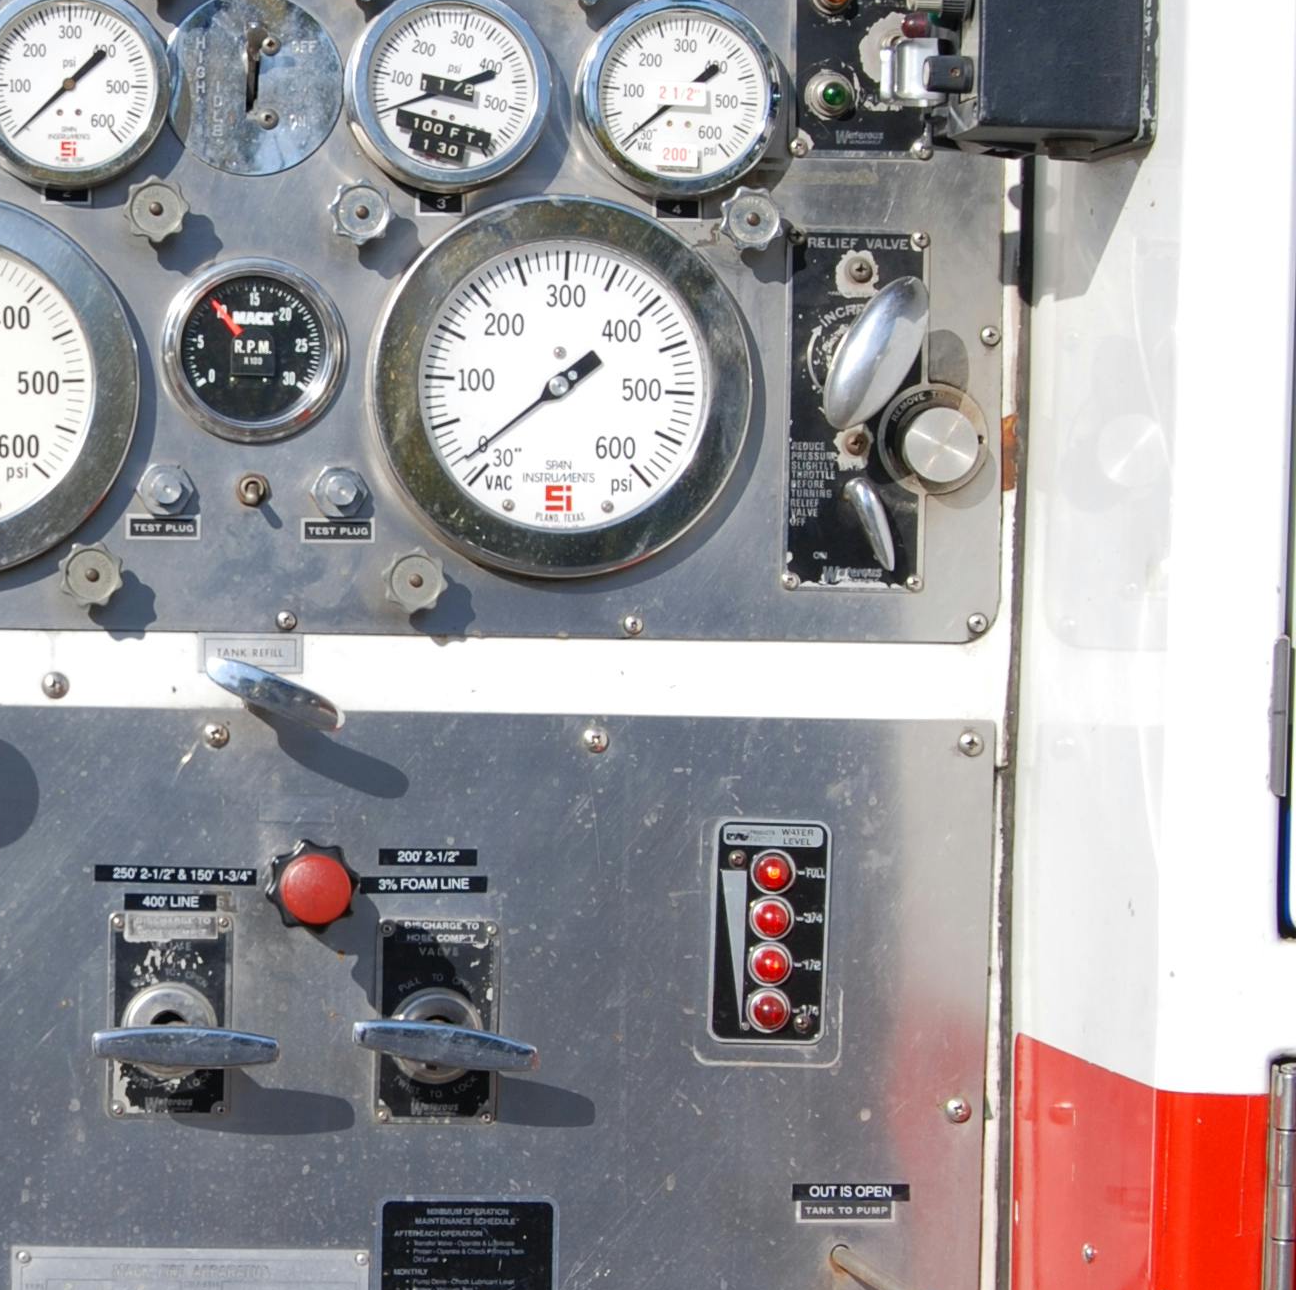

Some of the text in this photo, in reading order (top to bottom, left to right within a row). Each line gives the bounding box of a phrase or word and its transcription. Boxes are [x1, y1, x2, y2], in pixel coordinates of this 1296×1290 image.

[59, 26, 82, 39] 300
[451, 31, 474, 48] 300
[23, 44, 46, 57] 200
[412, 40, 436, 57] 200
[391, 70, 413, 87] 100
[10, 80, 31, 92] 100
[106, 81, 129, 93] 500
[484, 95, 507, 113] 500
[91, 115, 114, 127] 600
[637, 142, 651, 151] VAC
[437, 198, 446, 209] 3
[672, 204, 681, 214] 4
[808, 237, 908, 250] RELIEF VALVE
[546, 285, 586, 308] 300
[232, 311, 274, 325] MACK
[485, 313, 524, 336] 200
[602, 320, 641, 343] 400
[234, 340, 272, 354] R.P.M.
[18, 371, 59, 395] 500
[458, 368, 494, 391] 100
[622, 379, 661, 401] 500
[596, 437, 635, 460] 600
[791, 442, 825, 451] REDUCE
[546, 460, 572, 471] SPAN
[791, 461, 835, 470] SLIGHTLY
[522, 472, 595, 484] INSTRUMENTS
[791, 471, 835, 480] THROTTLE
[485, 475, 512, 491] VAC
[791, 480, 824, 488] BEFORE
[791, 490, 832, 498] TURNING
[791, 499, 819, 507] RELIEF
[563, 512, 586, 522] TEXAS
[791, 509, 818, 517] VALVE
[133, 524, 194, 533] TEST PLUG
[308, 527, 368, 536] TEST PLUG
[217, 648, 284, 658] TANK REFILL
[781, 829, 814, 837] WATER
[783, 837, 811, 845] LEVEL
[397, 851, 460, 862] 200' 2-1/2"
[113, 867, 252, 881] 250' 2-1/2" & 150' 1-3/4"
[806, 867, 825, 878] FULL
[378, 878, 469, 890] 3% FOAM LINE
[142, 896, 199, 907] 400' LINE
[804, 913, 823, 924] 3/4
[404, 921, 462, 929] DISCHARGE
[419, 947, 458, 956] VALVE
[809, 1186, 892, 1197] OUT IS OPEN
